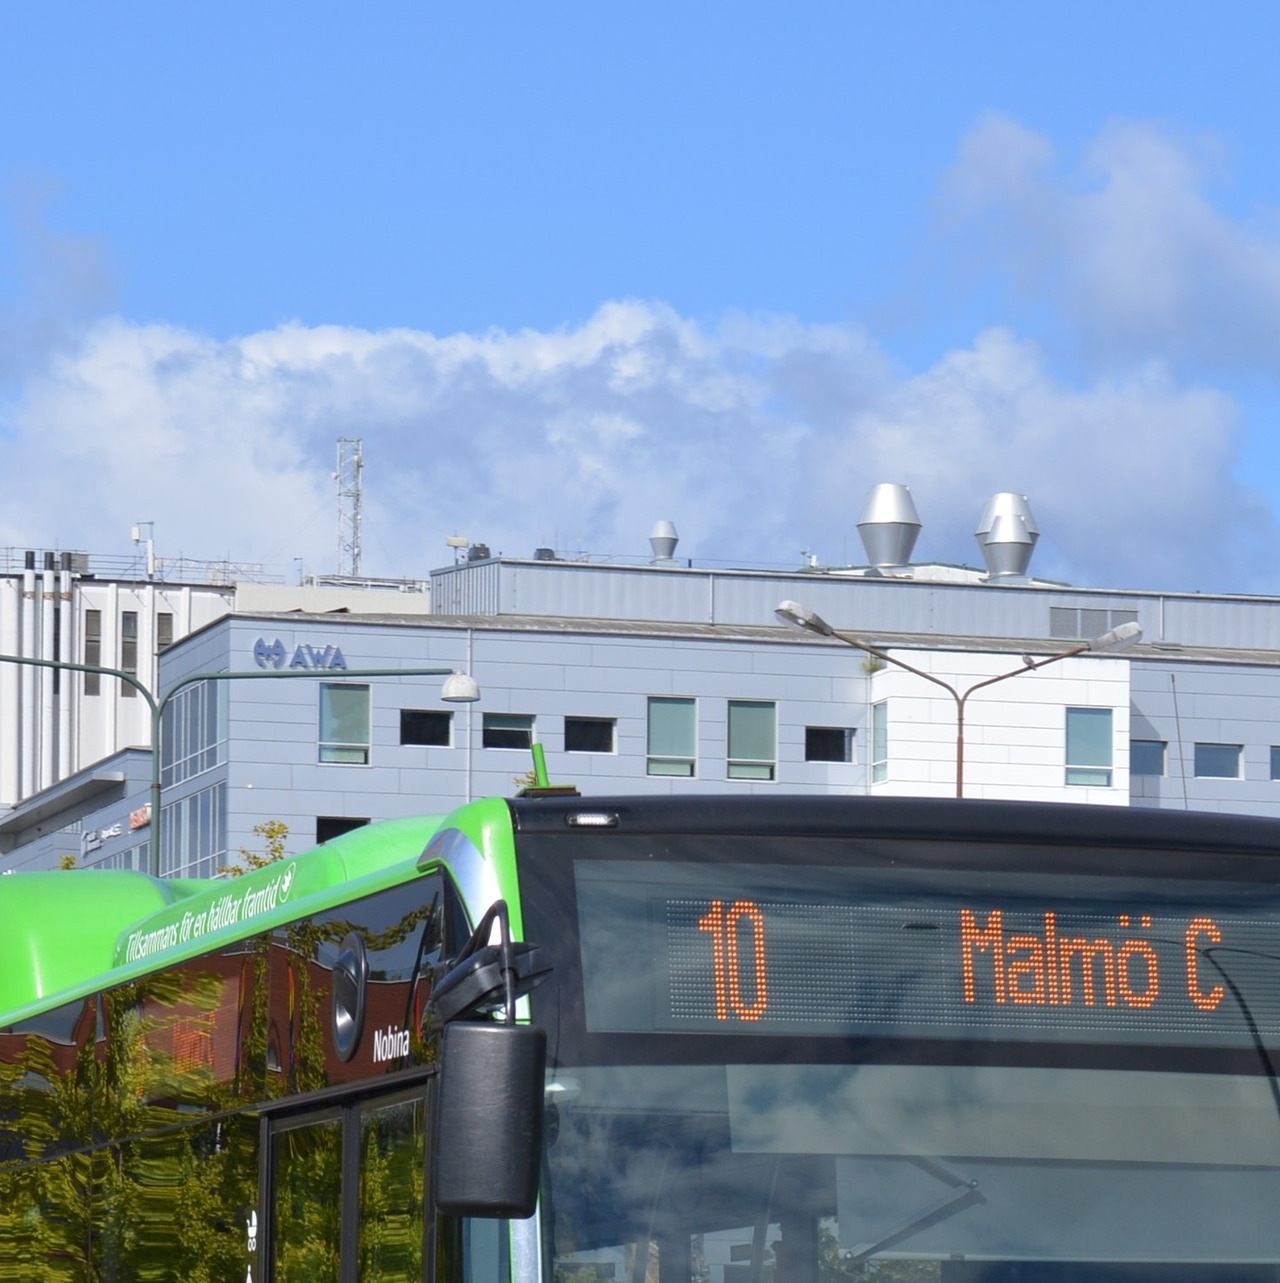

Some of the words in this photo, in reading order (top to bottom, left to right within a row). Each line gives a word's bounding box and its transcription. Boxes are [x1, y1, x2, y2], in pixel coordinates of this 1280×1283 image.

[289, 644, 347, 669] AWA
[126, 922, 180, 963] Tillsammans
[180, 912, 196, 943] för
[194, 913, 210, 937] en
[207, 894, 244, 933] hållbar
[242, 875, 282, 918] framtid
[698, 899, 768, 1021] 10
[960, 908, 1159, 1007] Malmö
[1185, 916, 1225, 1011] C
[373, 1024, 410, 1063] Nobina
